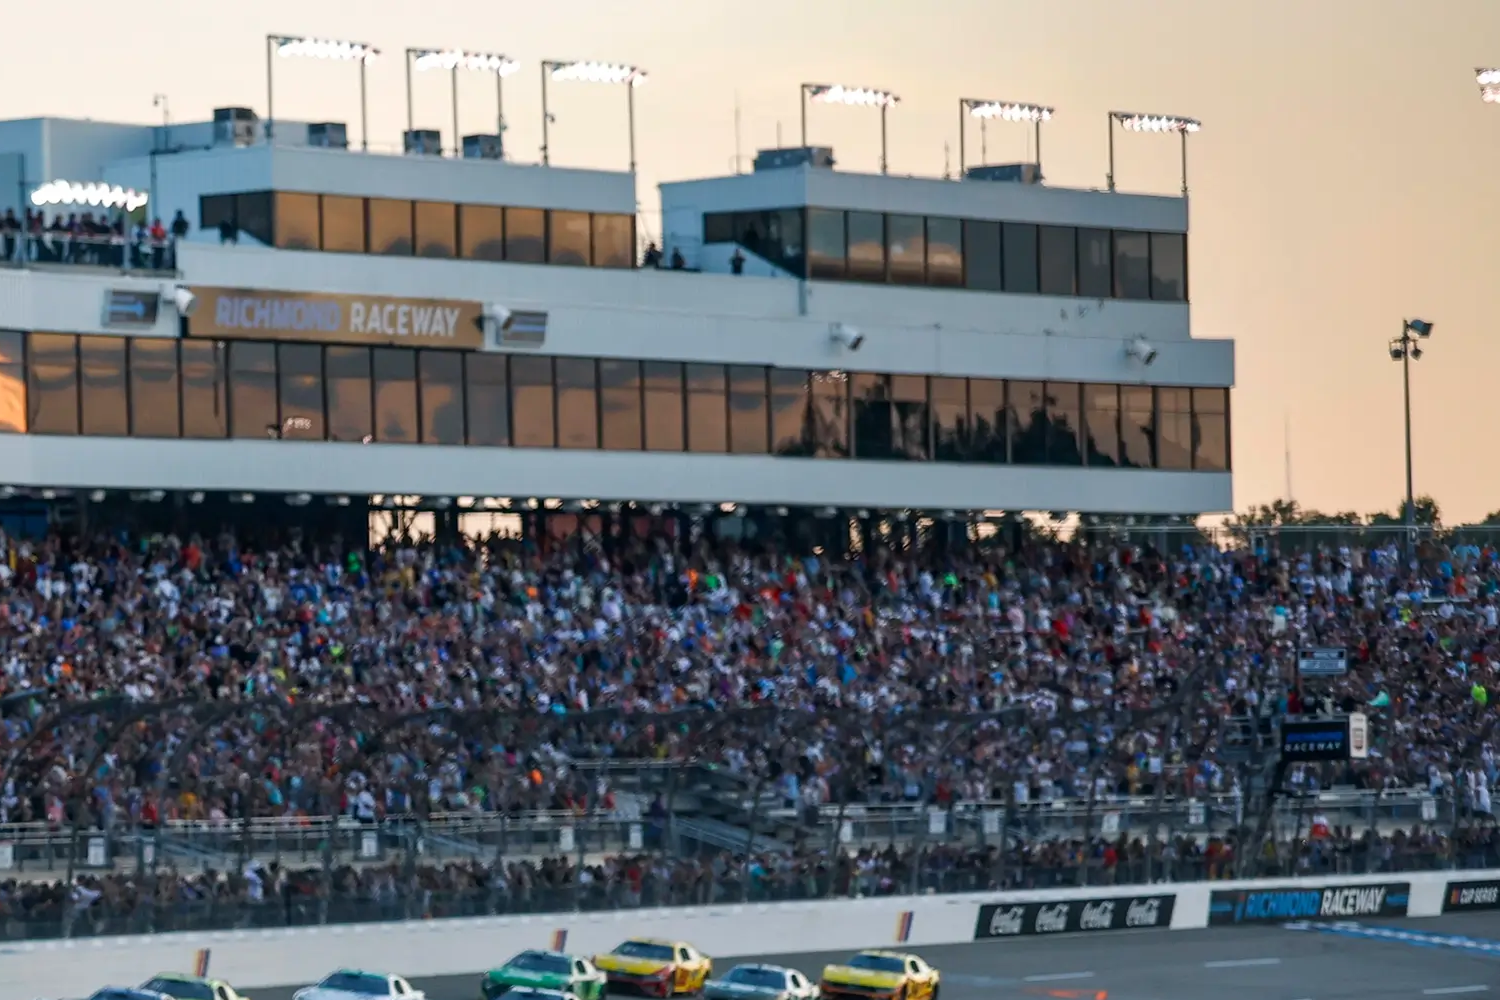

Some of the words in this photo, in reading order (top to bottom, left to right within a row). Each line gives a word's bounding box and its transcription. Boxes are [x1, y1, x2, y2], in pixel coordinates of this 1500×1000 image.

[214, 296, 341, 331] RICHMOND
[350, 302, 462, 338] RACEWAY
[1244, 890, 1321, 918] RICHMOND
[1320, 886, 1387, 917] RACEWAY
